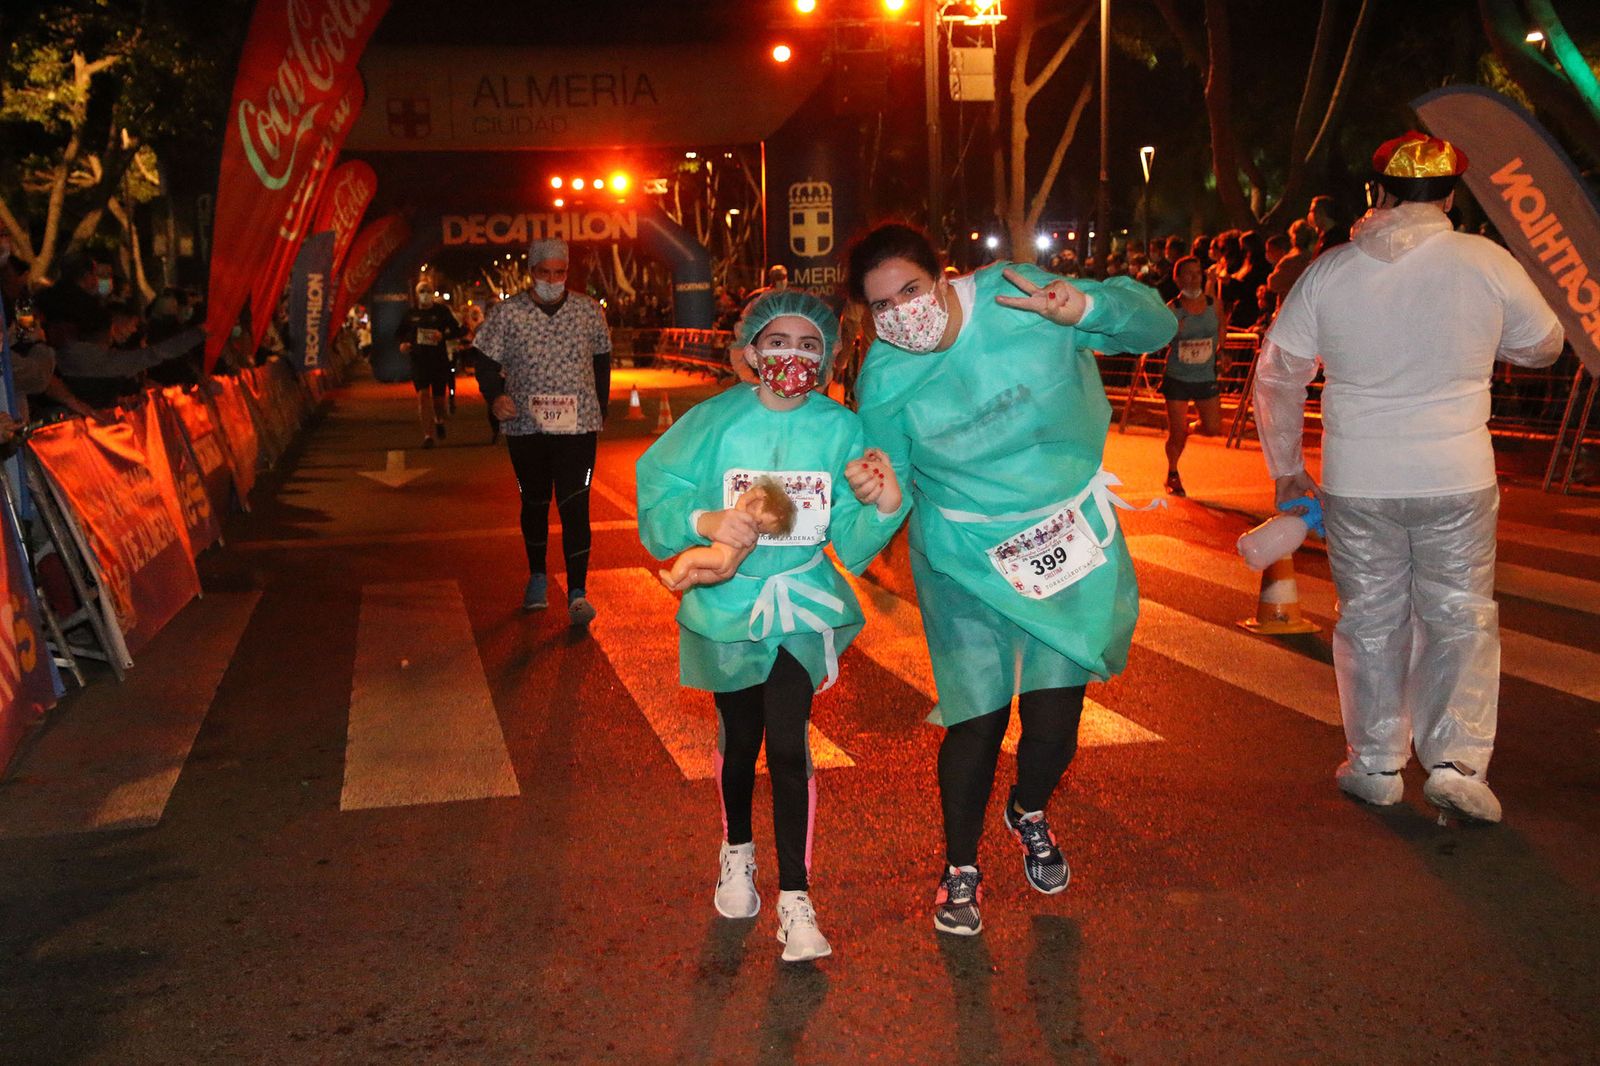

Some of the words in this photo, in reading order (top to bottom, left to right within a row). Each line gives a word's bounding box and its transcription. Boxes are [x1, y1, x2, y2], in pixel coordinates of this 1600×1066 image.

[238, 0, 372, 190] Coca-Cola
[473, 66, 659, 108] ALMERÍA
[473, 117, 568, 135] CIUDAD
[442, 209, 639, 246] DECATHLON
[304, 272, 324, 367] DECATHLON
[543, 410, 562, 421] 397
[1030, 546, 1067, 576] 399
